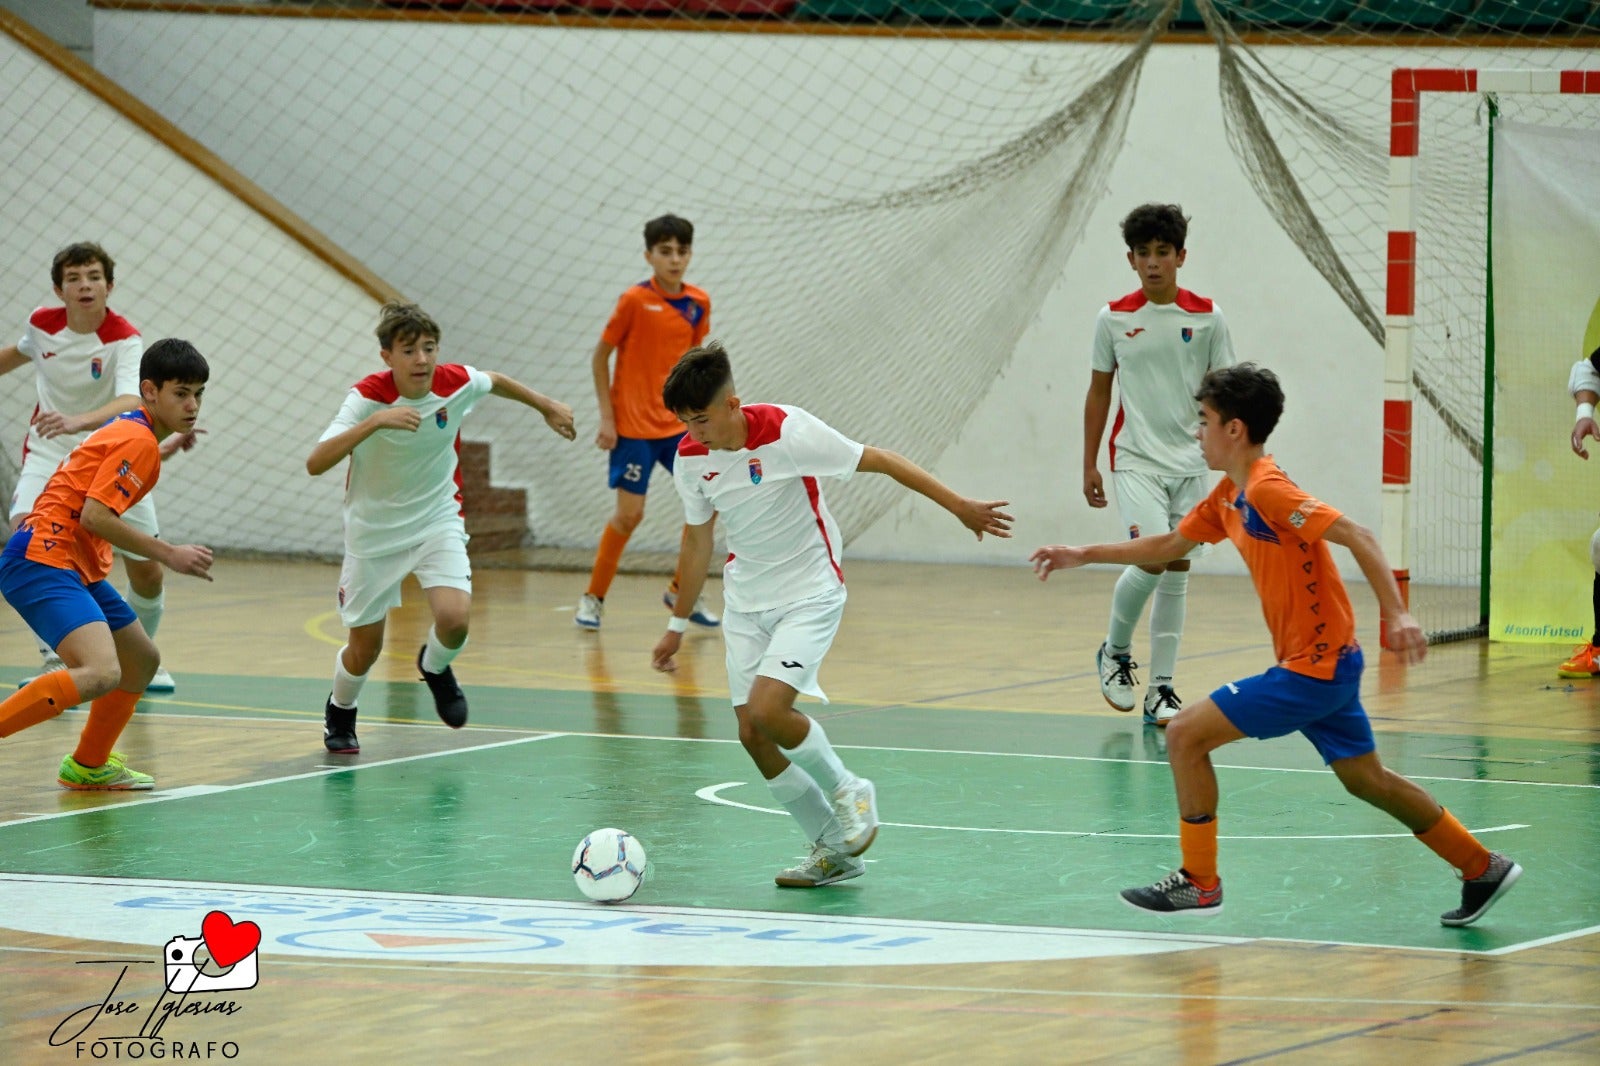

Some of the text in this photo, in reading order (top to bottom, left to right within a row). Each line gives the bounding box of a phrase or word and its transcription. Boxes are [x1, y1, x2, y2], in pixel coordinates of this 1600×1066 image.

[624, 463, 642, 482] 25
[1504, 624, 1584, 638] #somFutsal
[113, 896, 933, 950] inapelsa
